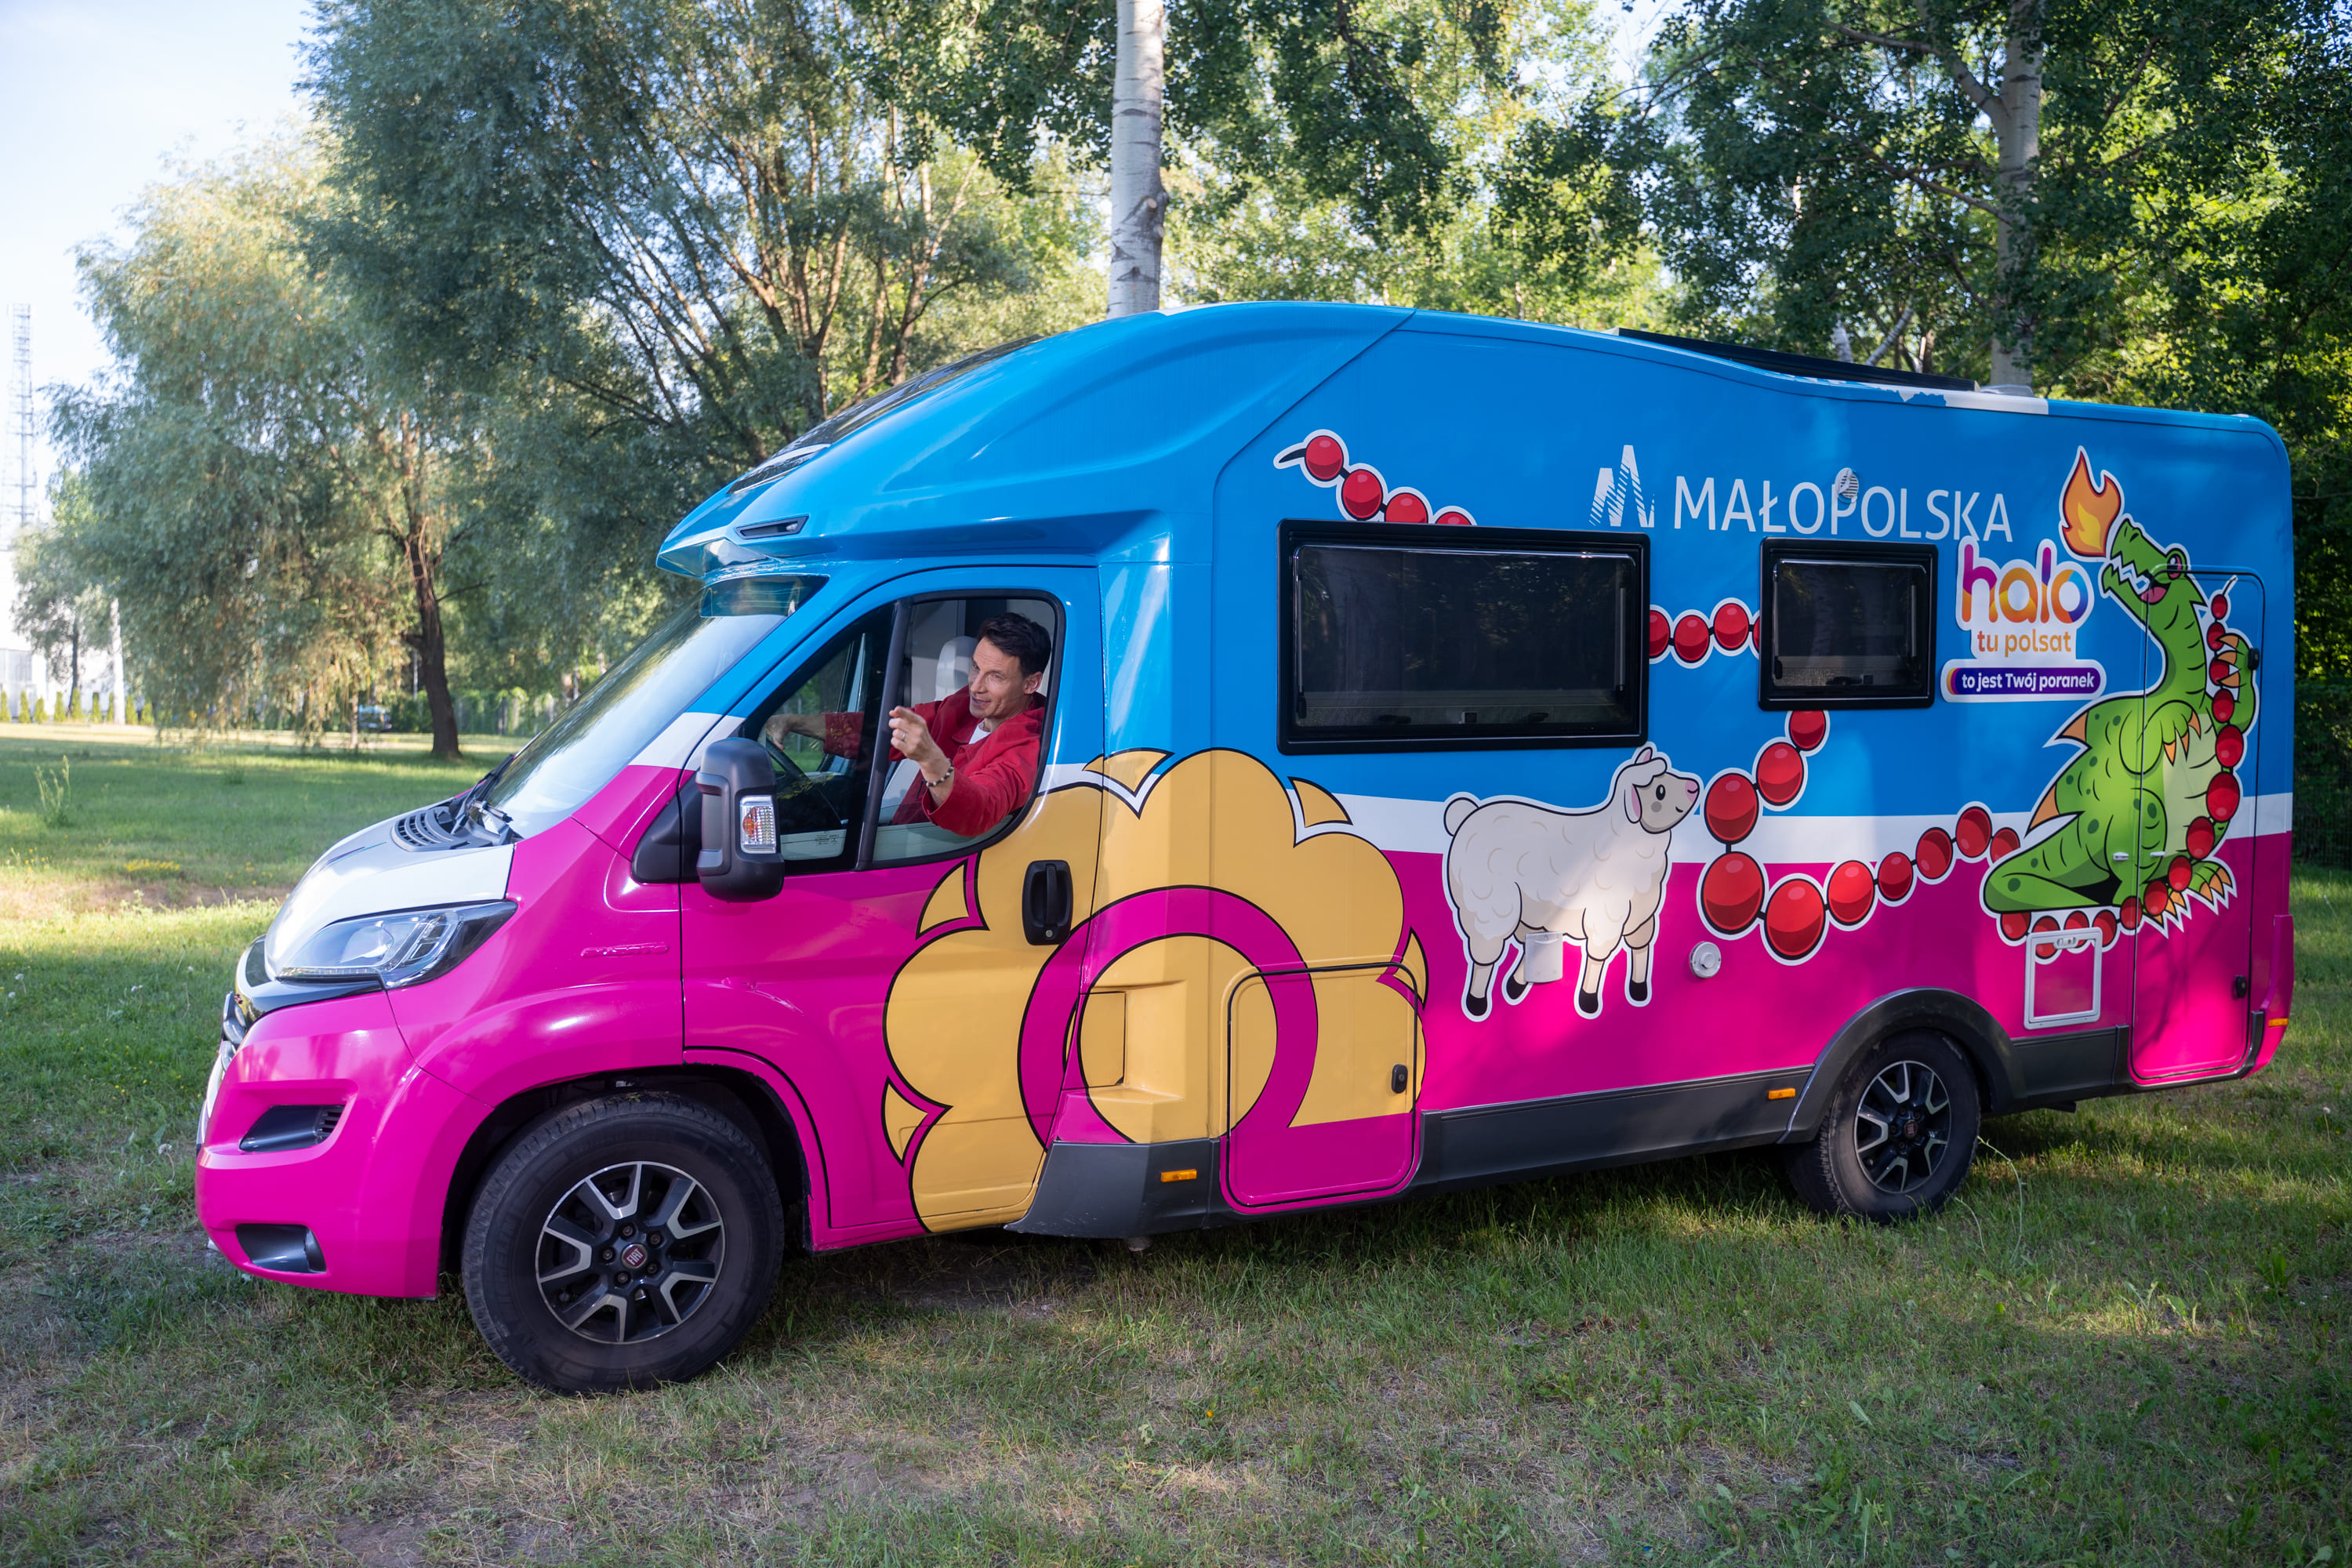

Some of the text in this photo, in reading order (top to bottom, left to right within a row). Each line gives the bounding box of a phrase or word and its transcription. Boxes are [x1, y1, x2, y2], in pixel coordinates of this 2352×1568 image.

[1674, 475, 2013, 543] MAŁOPOLSKA
[1961, 543, 2089, 624] halo
[1976, 629, 2071, 658] tu polsat
[1962, 672, 2095, 692] to jest Twój poranek
[626, 1248, 644, 1265] FIAT
